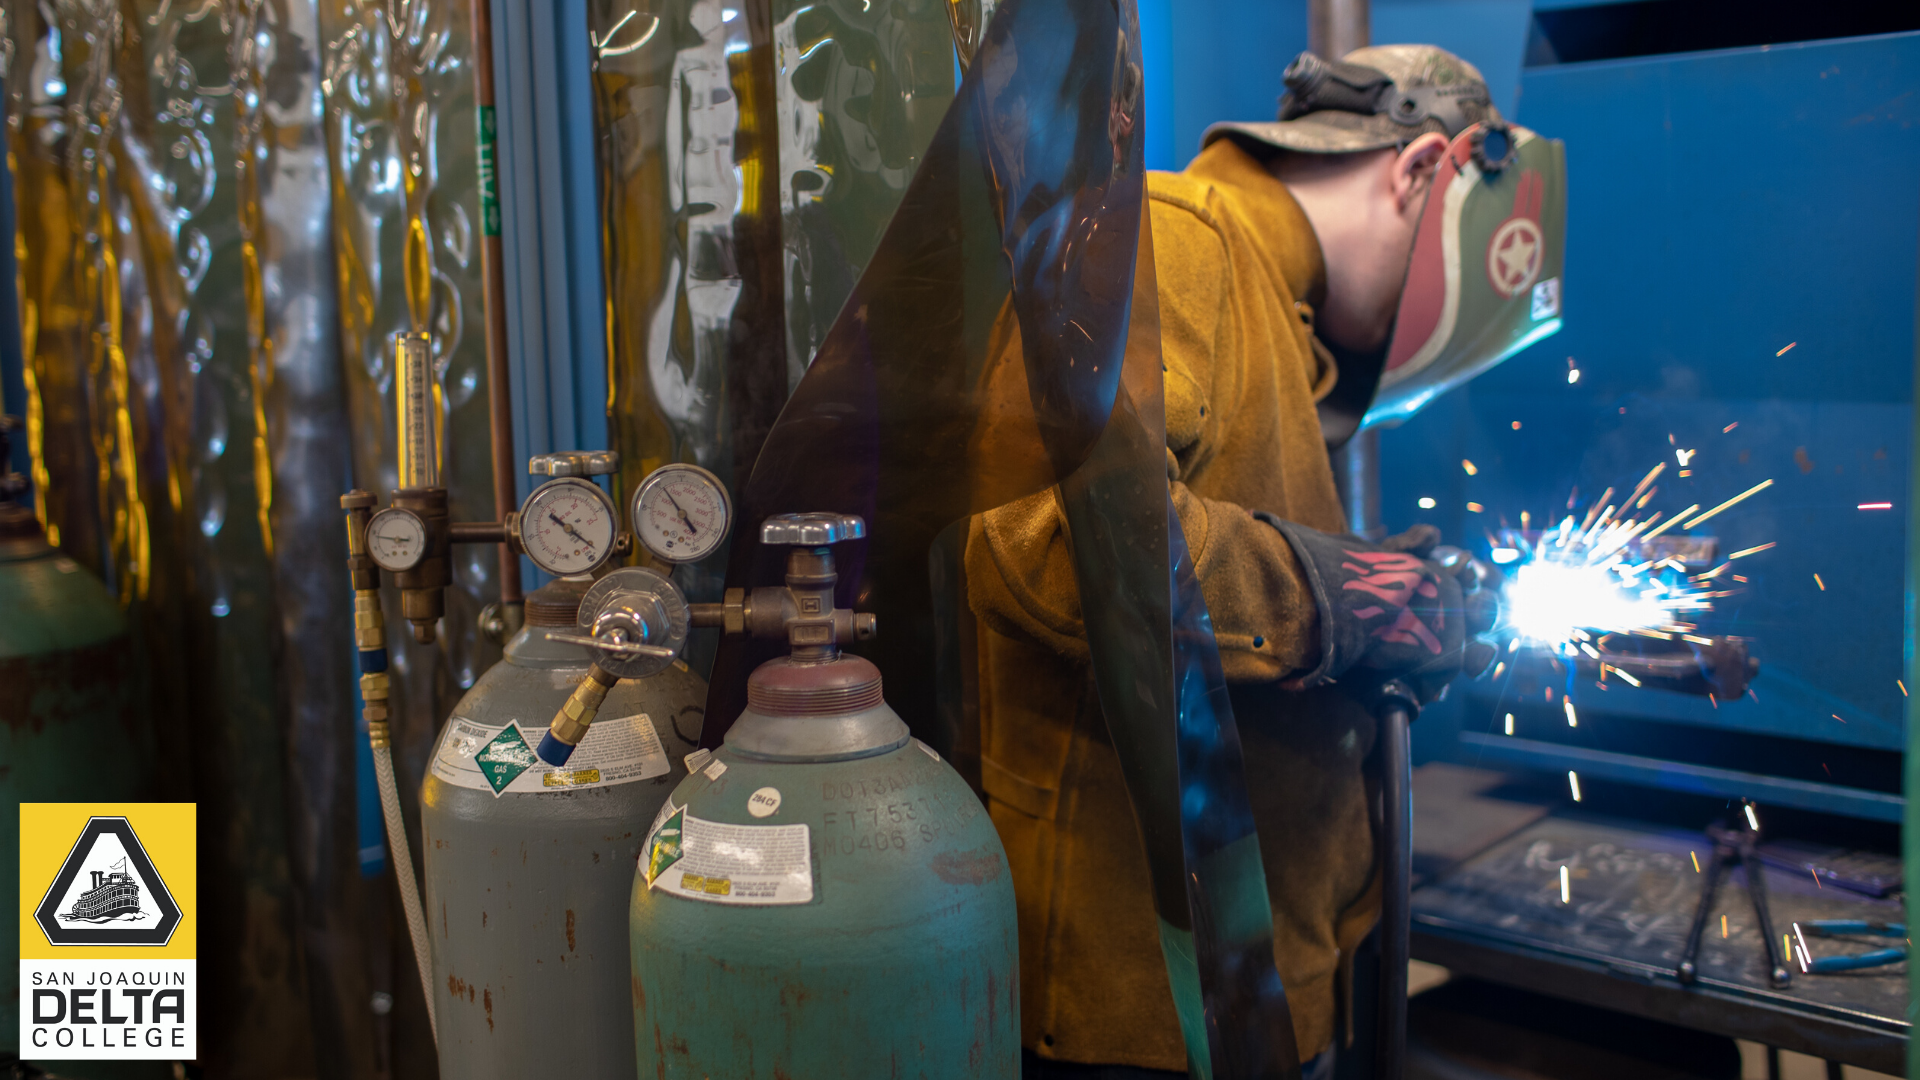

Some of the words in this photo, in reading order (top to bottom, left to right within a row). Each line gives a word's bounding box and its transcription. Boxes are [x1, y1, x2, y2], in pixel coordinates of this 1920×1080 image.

[670, 488, 682, 497] 1500
[683, 487, 696, 496] 2000
[660, 498, 673, 506] 1000
[694, 496, 707, 505] 2500
[570, 502, 579, 510] 20
[657, 510, 667, 518] 500
[695, 508, 709, 517] 3000
[586, 518, 594, 526] 25
[689, 545, 701, 553] 280
[494, 765, 508, 774] GAS
[496, 775, 502, 785] 2
[752, 793, 767, 804] 284
[765, 797, 778, 807] CF
